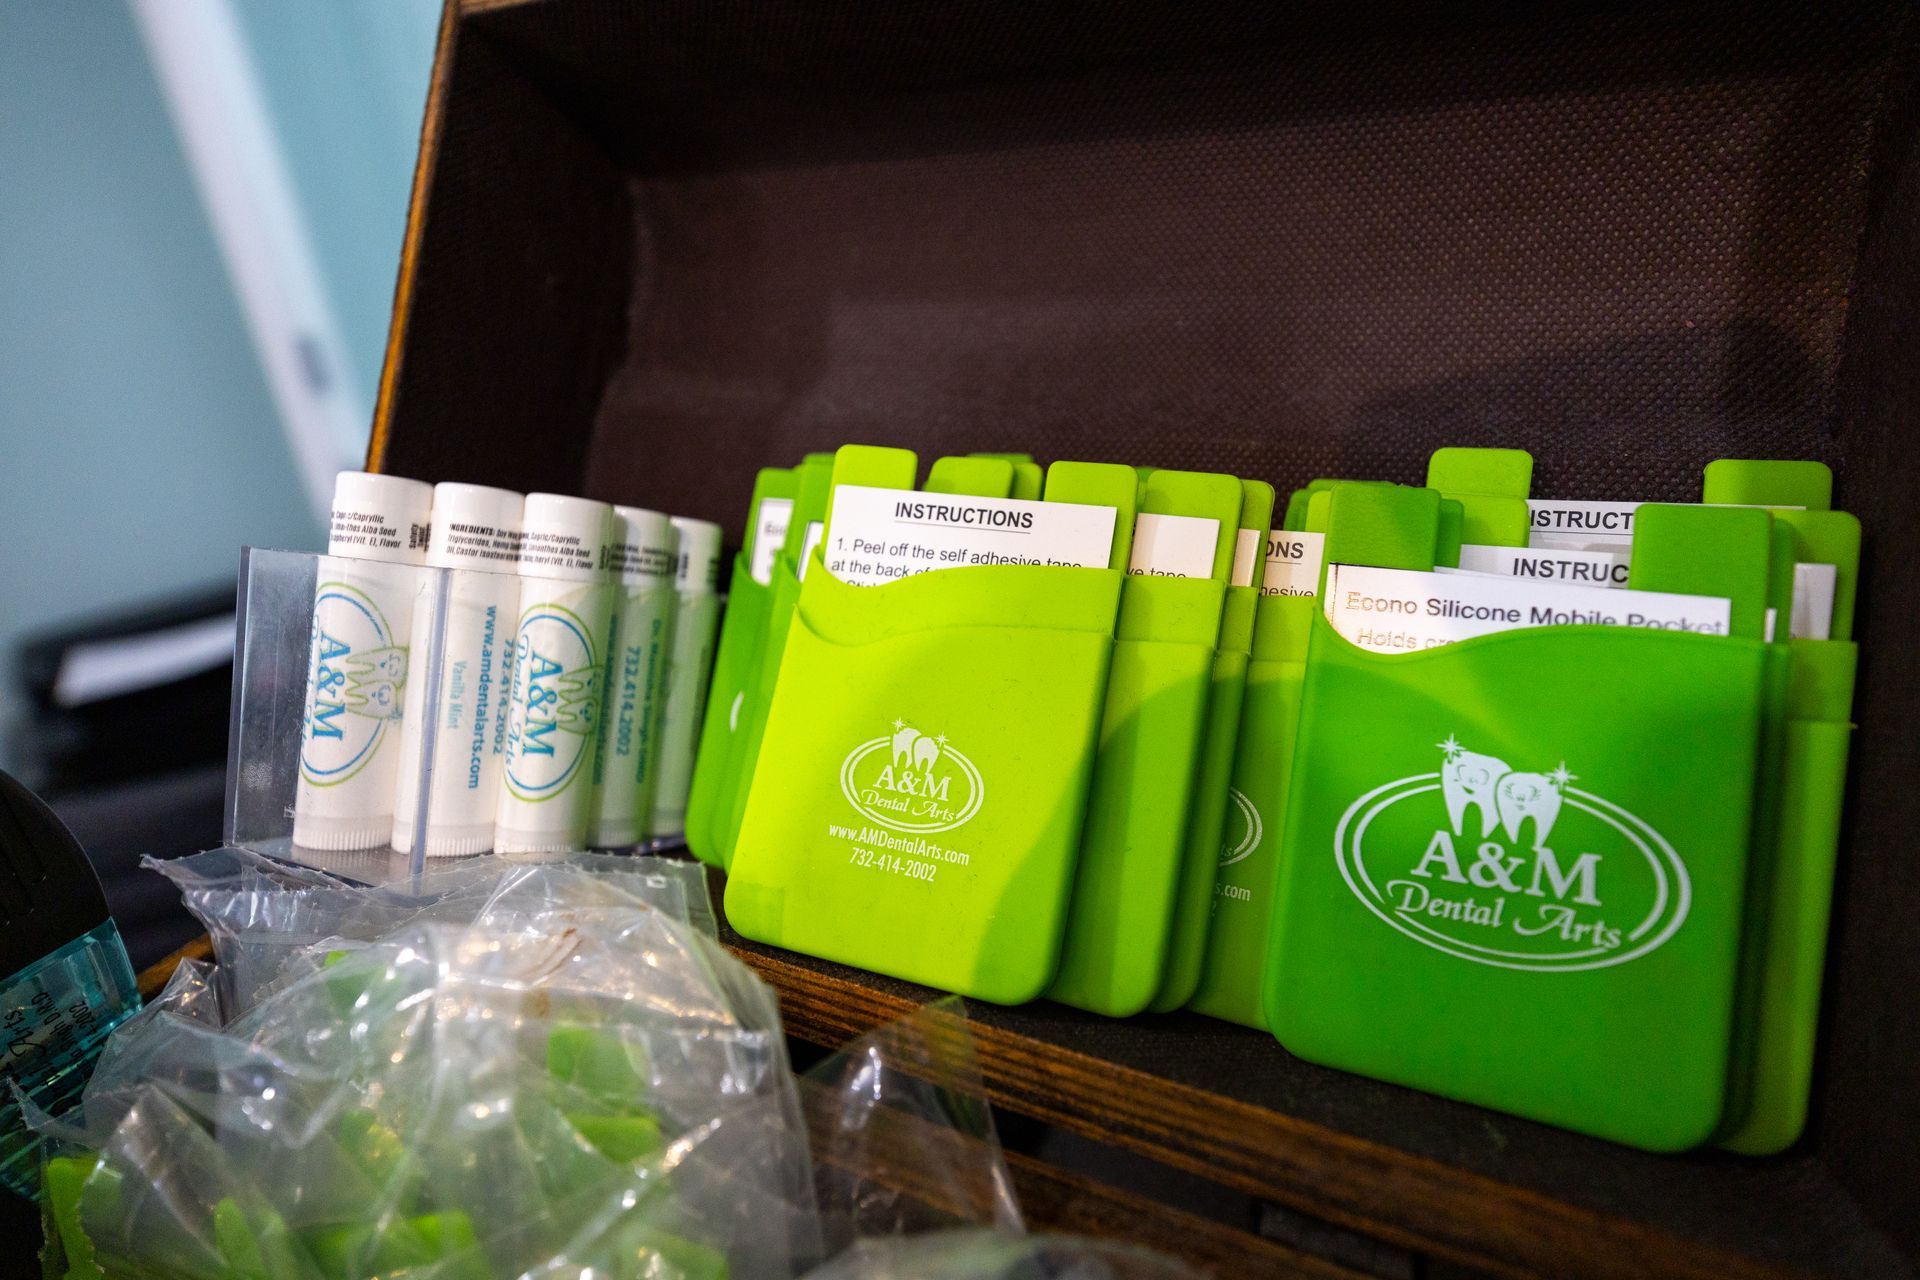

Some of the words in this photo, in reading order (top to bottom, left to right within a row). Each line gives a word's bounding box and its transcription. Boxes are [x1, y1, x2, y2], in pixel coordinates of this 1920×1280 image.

[895, 502, 1034, 528] INSTRUCTIONS
[832, 560, 845, 572] at
[849, 560, 871, 574] the
[875, 562, 910, 577] back
[837, 538, 848, 552] 1.
[853, 539, 885, 555] Peel
[889, 543, 910, 557] off
[912, 545, 935, 559] the
[940, 548, 968, 562] self
[970, 551, 1041, 567] adhesive
[1346, 591, 1418, 614] Econo
[1426, 598, 1521, 623] Silicone
[1530, 606, 1616, 626] Mobile
[312, 630, 351, 741] A&M
[468, 605, 497, 789] www.amdentalarts.com
[522, 650, 563, 757] A&M
[872, 764, 952, 802] A&M
[861, 789, 910, 812] Dental
[912, 801, 954, 822] Arts
[828, 824, 969, 866] www.AMDentalArts.com
[850, 847, 937, 882] 732-414-2002
[1410, 830, 1602, 907] A&M
[1386, 879, 1505, 928] Dental
[1513, 904, 1622, 949] Arts
